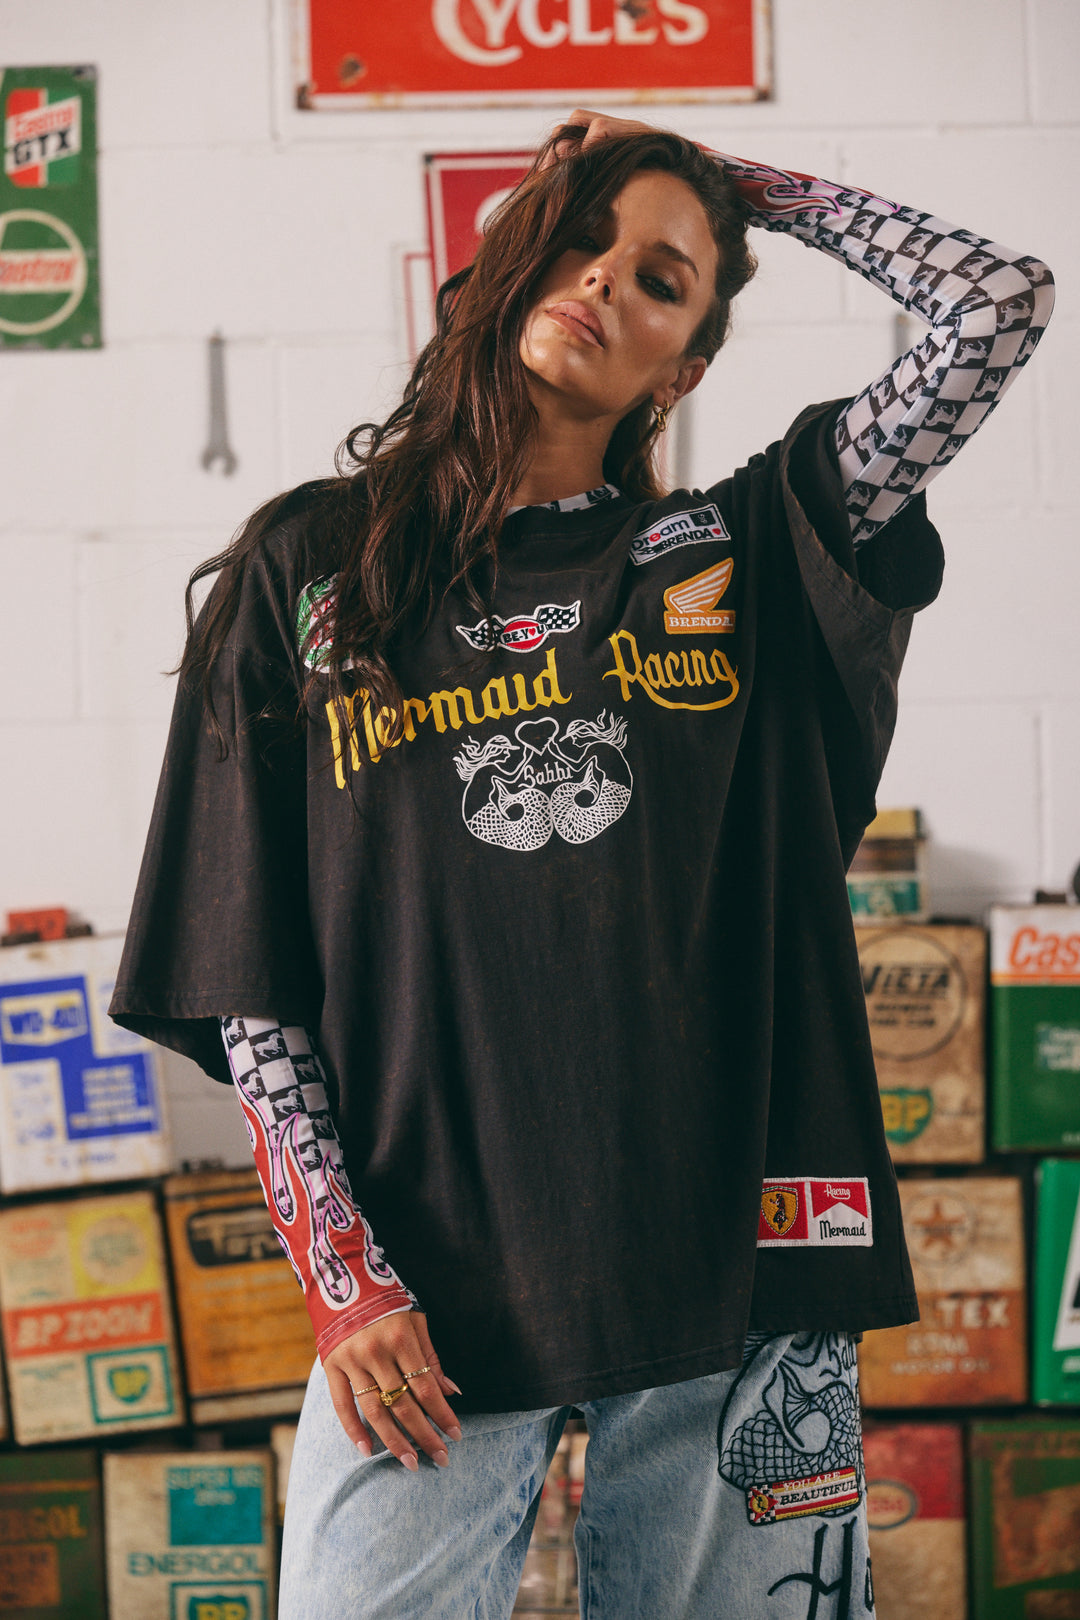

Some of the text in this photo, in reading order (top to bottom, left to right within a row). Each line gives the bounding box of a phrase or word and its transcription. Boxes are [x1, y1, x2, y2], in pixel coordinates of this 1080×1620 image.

[431, 0, 708, 66] CYCLES
[14, 128, 71, 165] GTX
[631, 519, 691, 551] Dream
[660, 528, 715, 550] BRENDA
[668, 615, 734, 628] BRENDA
[324, 629, 740, 790] Mermaid Racing
[880, 1094, 929, 1132] BP
[823, 1184, 851, 1200] Racing
[819, 1220, 867, 1240] Mermaid
[18, 1314, 62, 1348] BP
[779, 1480, 858, 1506] BEAUTIFUL
[782, 1470, 842, 1492] YOU ARE
